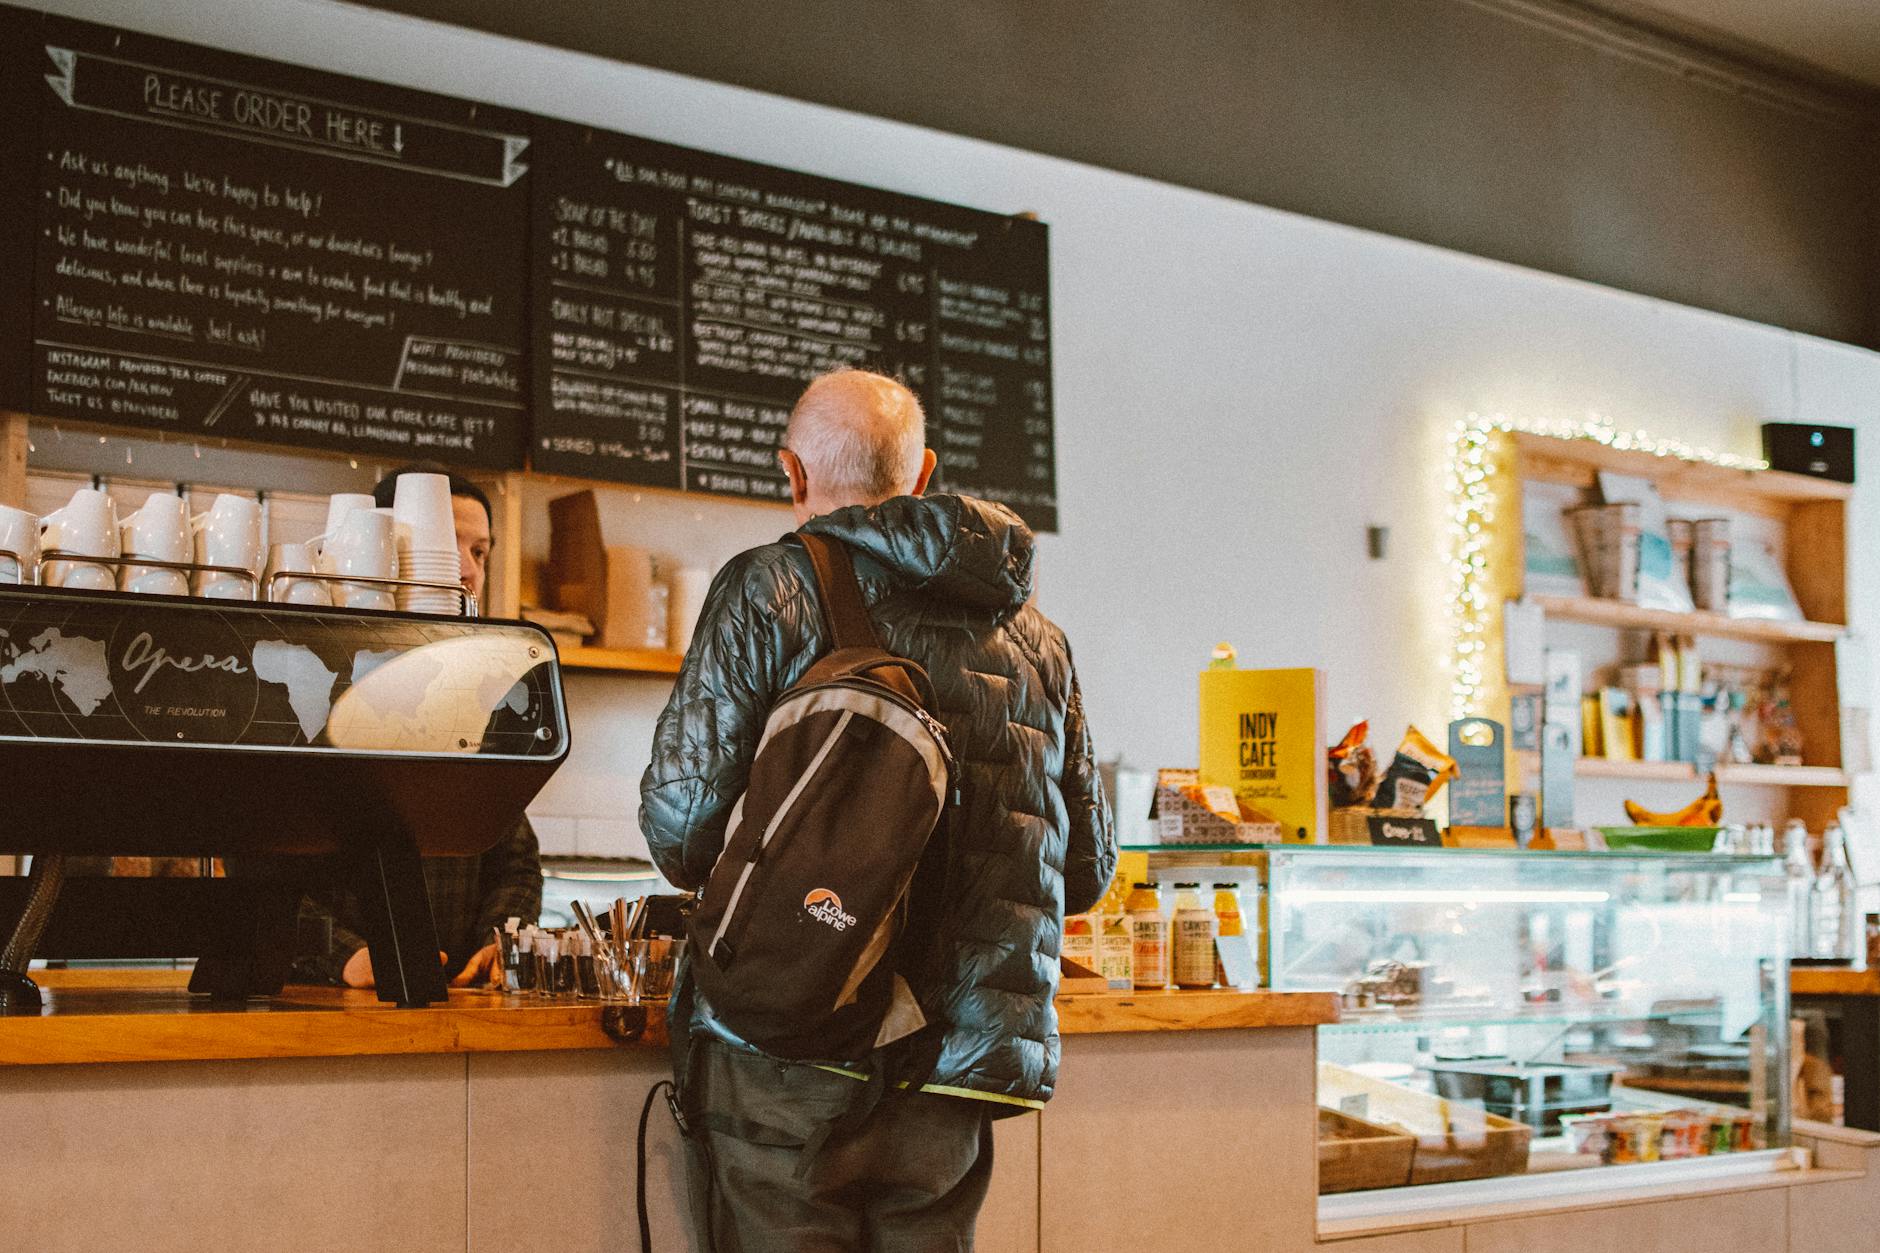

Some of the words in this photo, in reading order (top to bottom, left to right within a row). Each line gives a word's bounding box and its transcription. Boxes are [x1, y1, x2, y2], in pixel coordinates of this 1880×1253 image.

[144, 75, 222, 119] PLEASE
[233, 91, 313, 139] ORDER
[326, 111, 386, 151] HERE
[59, 150, 89, 175] Ask
[91, 162, 109, 178] us
[223, 176, 259, 211] happy
[263, 183, 280, 208] to
[58, 186, 81, 209] Did
[83, 197, 108, 222] you
[142, 207, 168, 229] you
[170, 210, 192, 227] can
[57, 224, 78, 248] We
[83, 228, 110, 253] have
[179, 243, 208, 268] local
[468, 295, 494, 316] and
[120, 269, 143, 288] and
[249, 389, 282, 410] HAVE
[122, 631, 248, 693] Opera
[144, 705, 161, 715] THE
[167, 706, 226, 717] REVOLUTION
[1240, 712, 1278, 739] INDY
[1240, 741, 1277, 768] CAFE
[807, 904, 846, 931] alpine
[821, 900, 857, 926] Lowe
